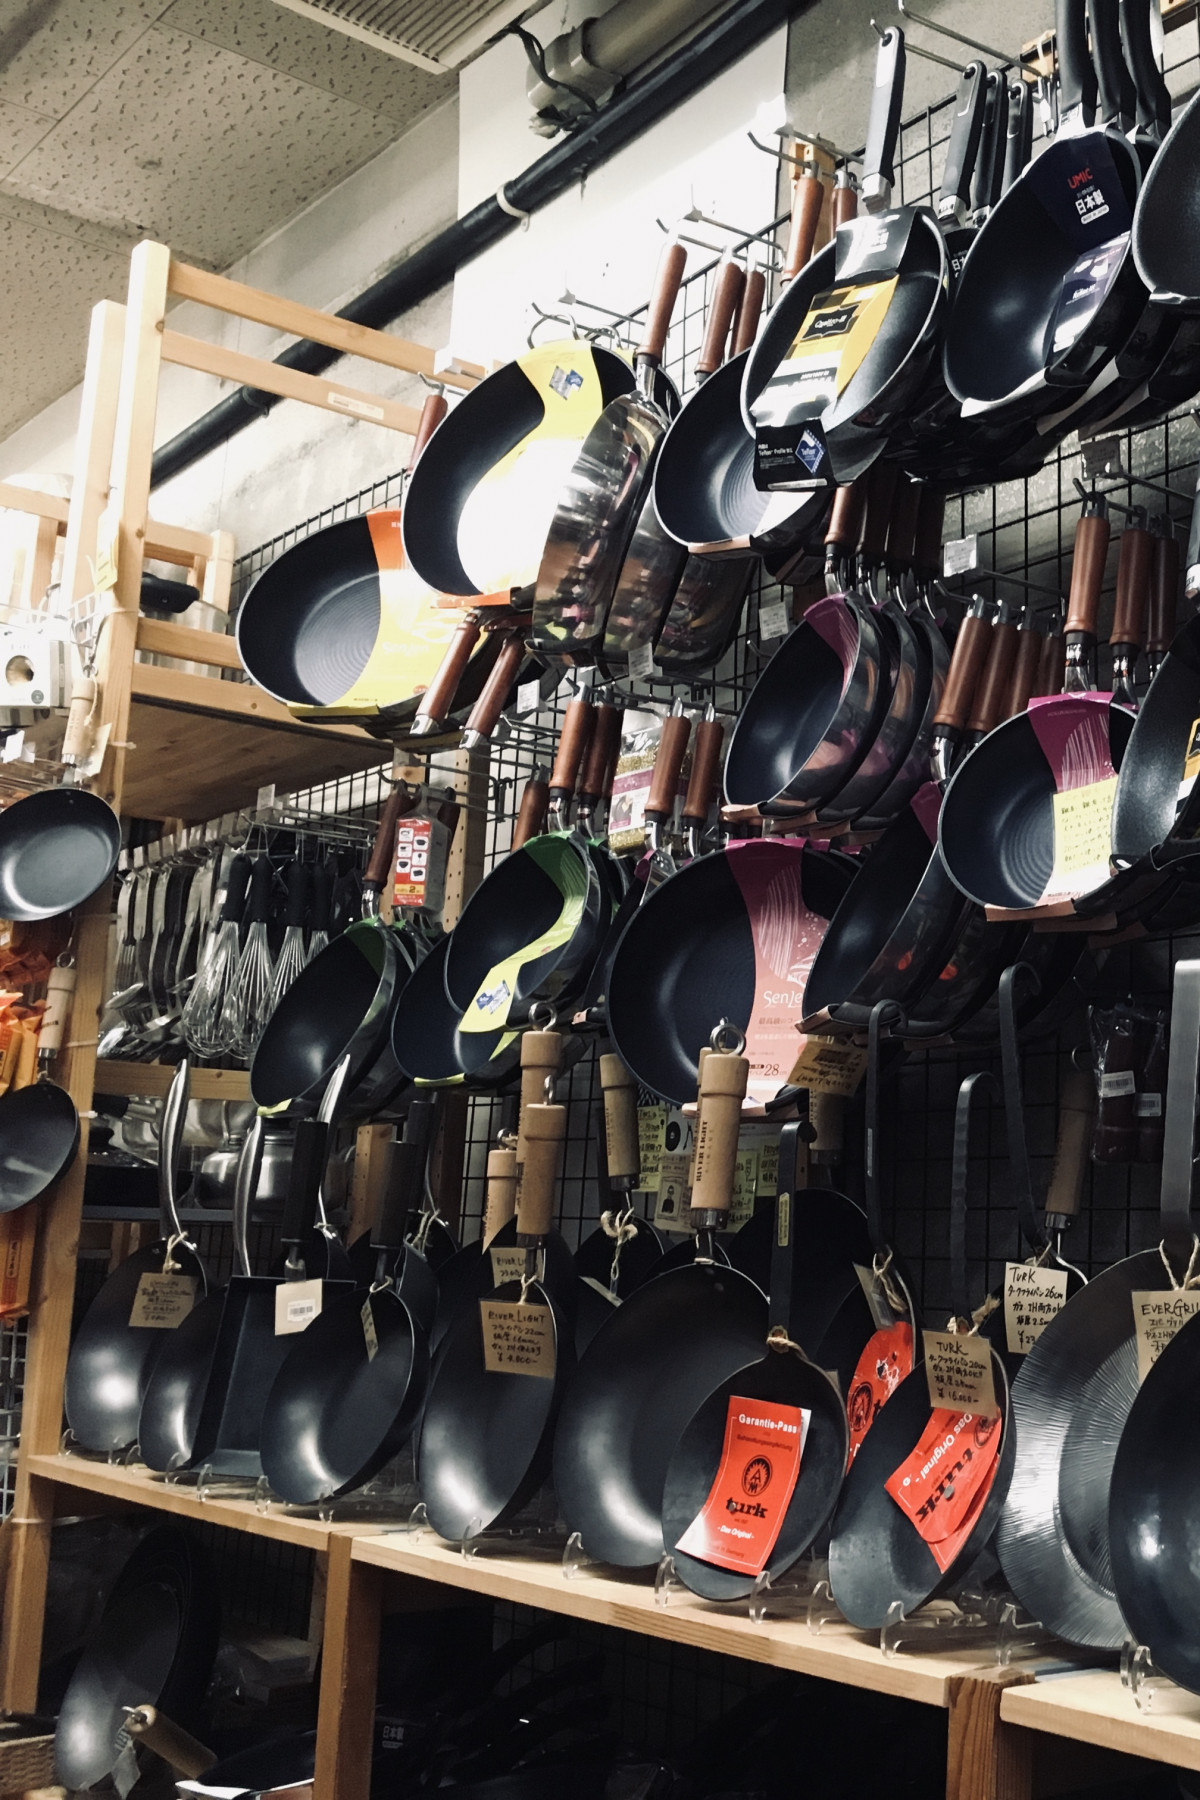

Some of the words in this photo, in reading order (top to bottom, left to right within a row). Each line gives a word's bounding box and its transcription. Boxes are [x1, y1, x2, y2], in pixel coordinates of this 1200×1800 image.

[1067, 168, 1093, 189] UMIC
[1075, 189, 1105, 215] 日本製
[764, 1063, 779, 1076] 28
[696, 1152, 704, 1182] RIVER
[700, 1121, 708, 1149] LIGHT
[738, 1413, 798, 1434] Garantie-Pass
[954, 1413, 973, 1435] Das
[920, 1434, 955, 1480] Original
[915, 1448, 974, 1523] turk
[725, 1497, 768, 1519] turk
